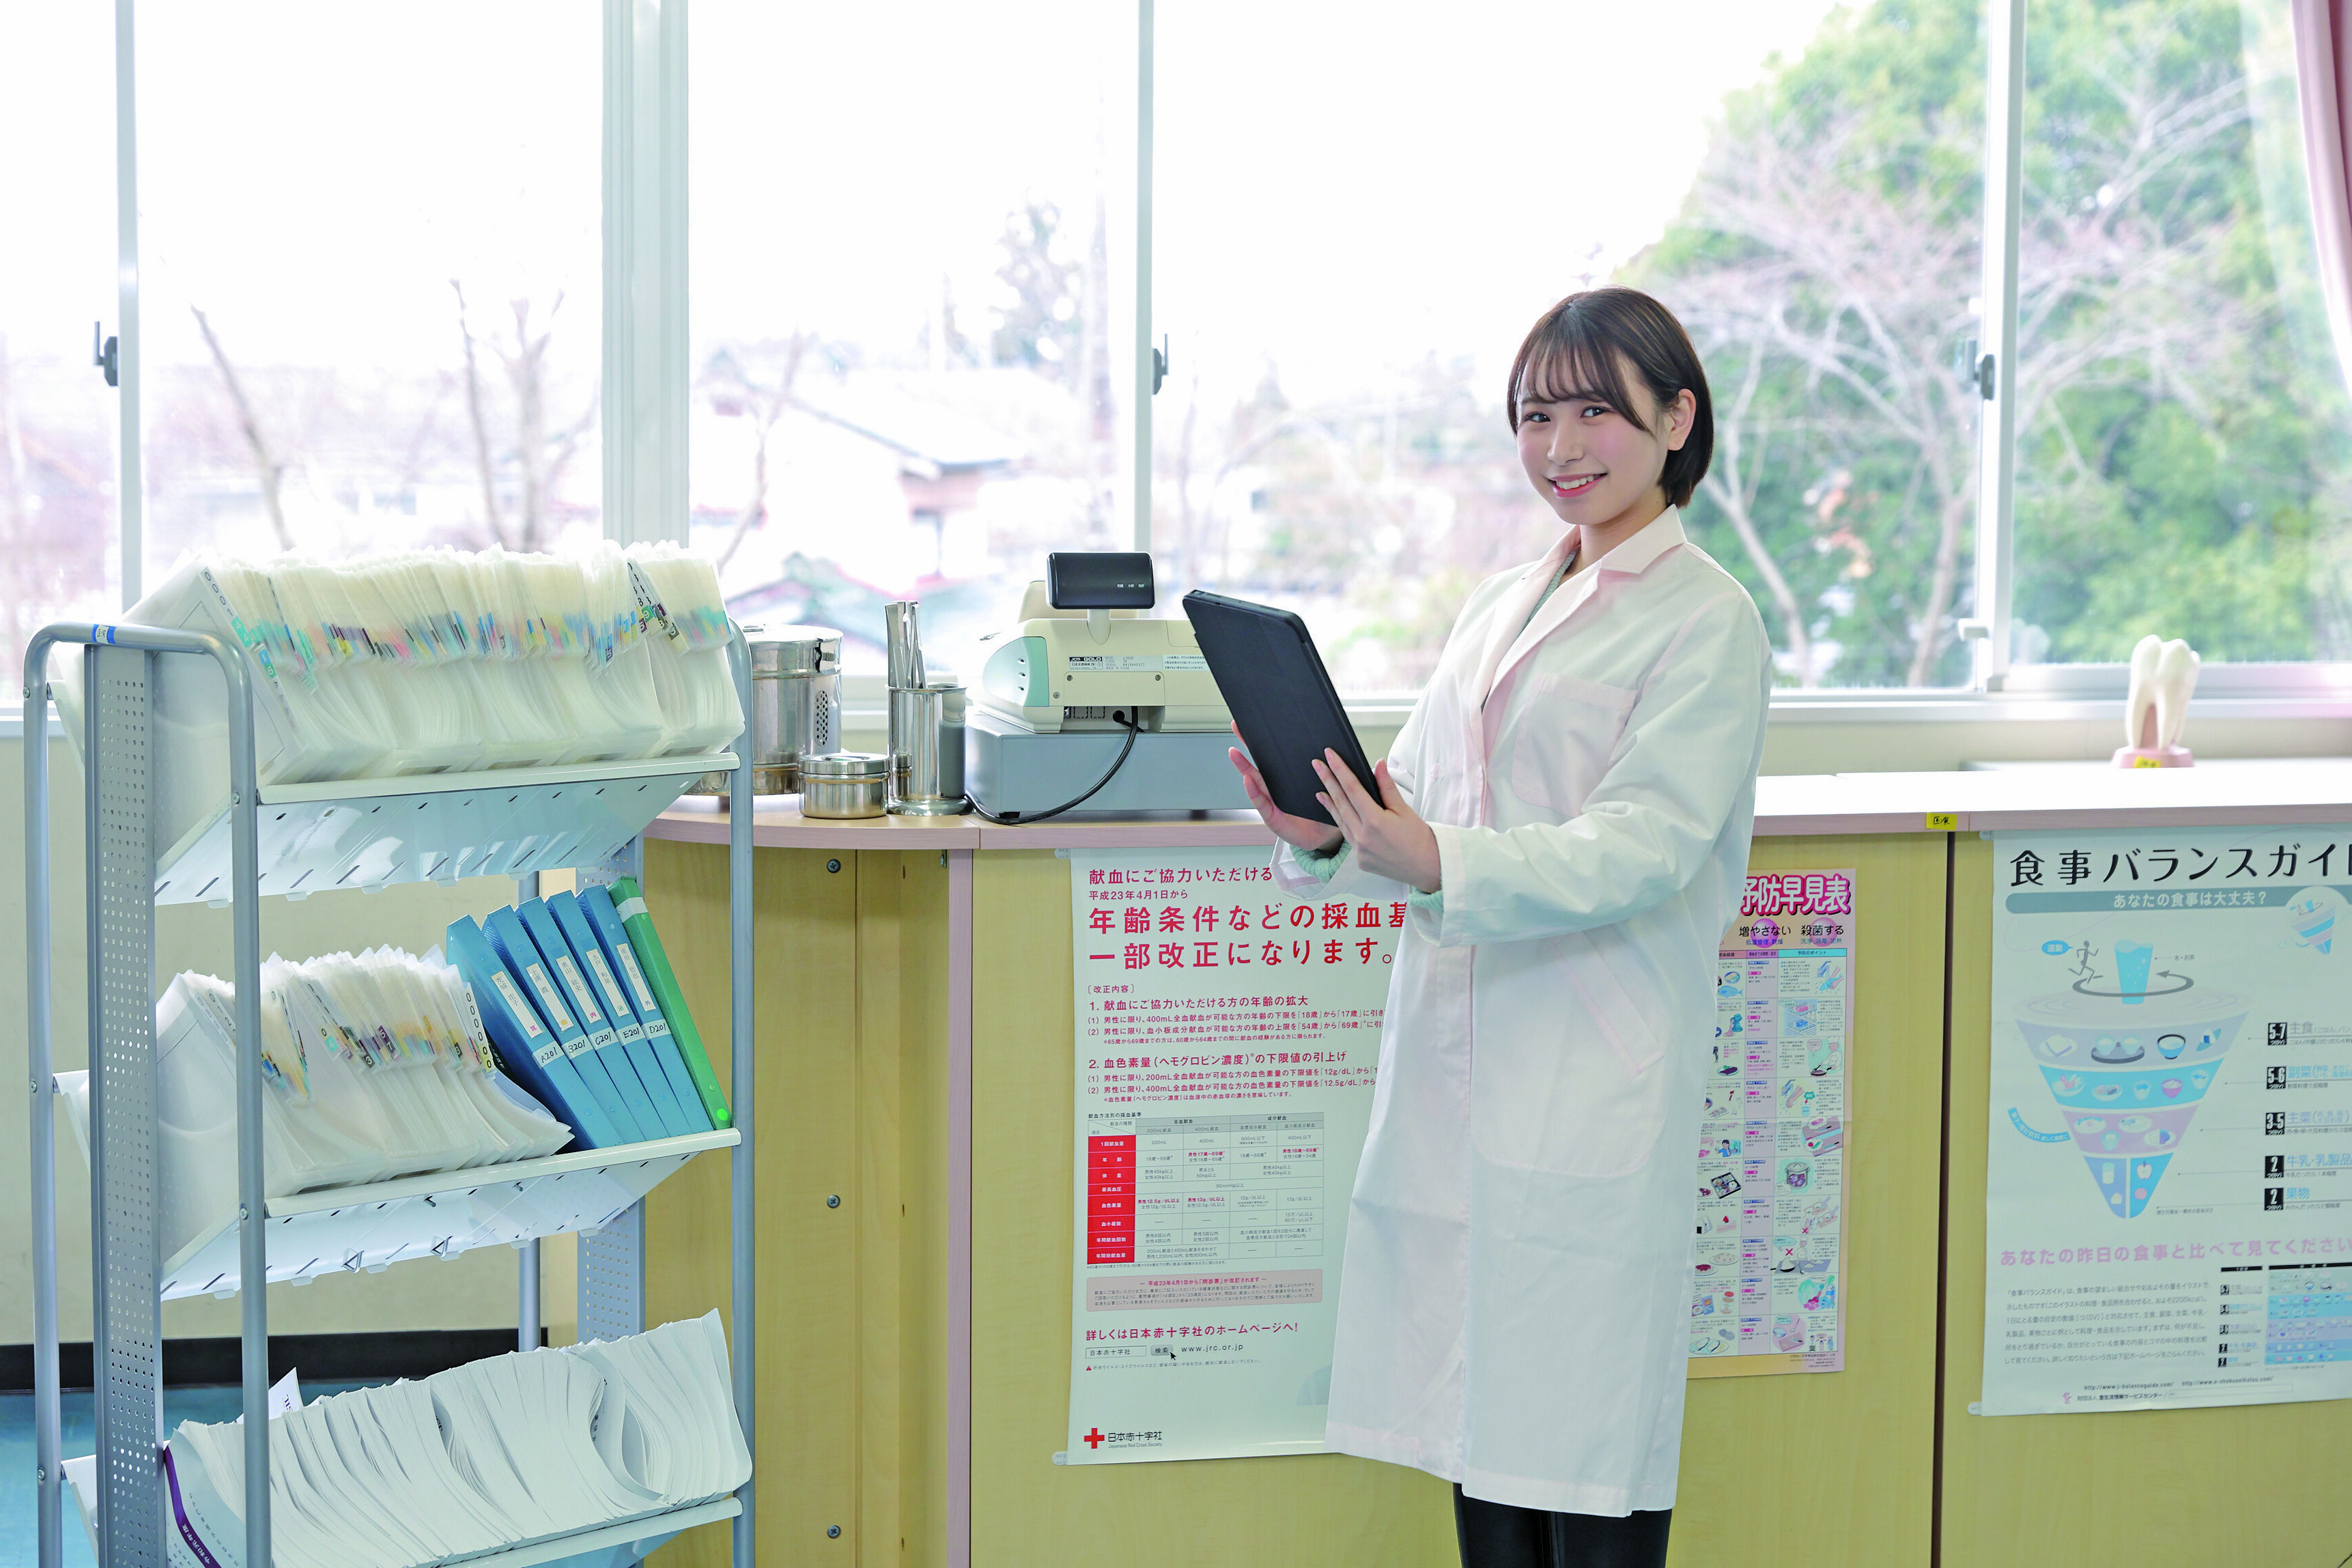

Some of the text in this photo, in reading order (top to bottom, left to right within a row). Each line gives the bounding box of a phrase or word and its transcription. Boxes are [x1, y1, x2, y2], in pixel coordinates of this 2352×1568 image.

[1089, 867, 1273, 885] 献血にご協力いただける
[1088, 889, 1189, 900] 平成23年4月1日から
[1089, 901, 1406, 934] 年齢条件などの採血基
[1739, 924, 1844, 937] 増やさない 殺菌する
[1089, 937, 1393, 969] 一部改正になります。
[1089, 995, 1309, 1011] 1. 献血にご協力いただける方の年齢の拡大
[1104, 1009, 1385, 1024] 男性に限り、400mL全血献血が可能な方の年齢の下限を「18歳」から「17歳」に引き
[623, 1027, 640, 1039] E201
[649, 1023, 667, 1034] D201
[1088, 1028, 1099, 1036] (2)
[2289, 1021, 2313, 1035] 主食
[595, 1031, 612, 1046] C201
[568, 1039, 586, 1054] B201
[540, 1046, 558, 1064] A201
[1089, 1059, 1100, 1069] 2.
[1088, 1074, 1099, 1083] (1)
[1088, 1086, 1099, 1094] (2)
[2271, 1156, 2278, 1172] 2
[2270, 1187, 2310, 1205] 2 果物
[2000, 1238, 2352, 1266] あなたの昨日の食事と比べて見てください
[1086, 1322, 1298, 1341] 詳しくは日本赤十字社のホームページへ!
[1090, 1348, 1131, 1356] 日本赤十字社
[1180, 1343, 1243, 1352] www.jrc.or.jp
[1108, 1431, 1162, 1442] 日本赤十字社
